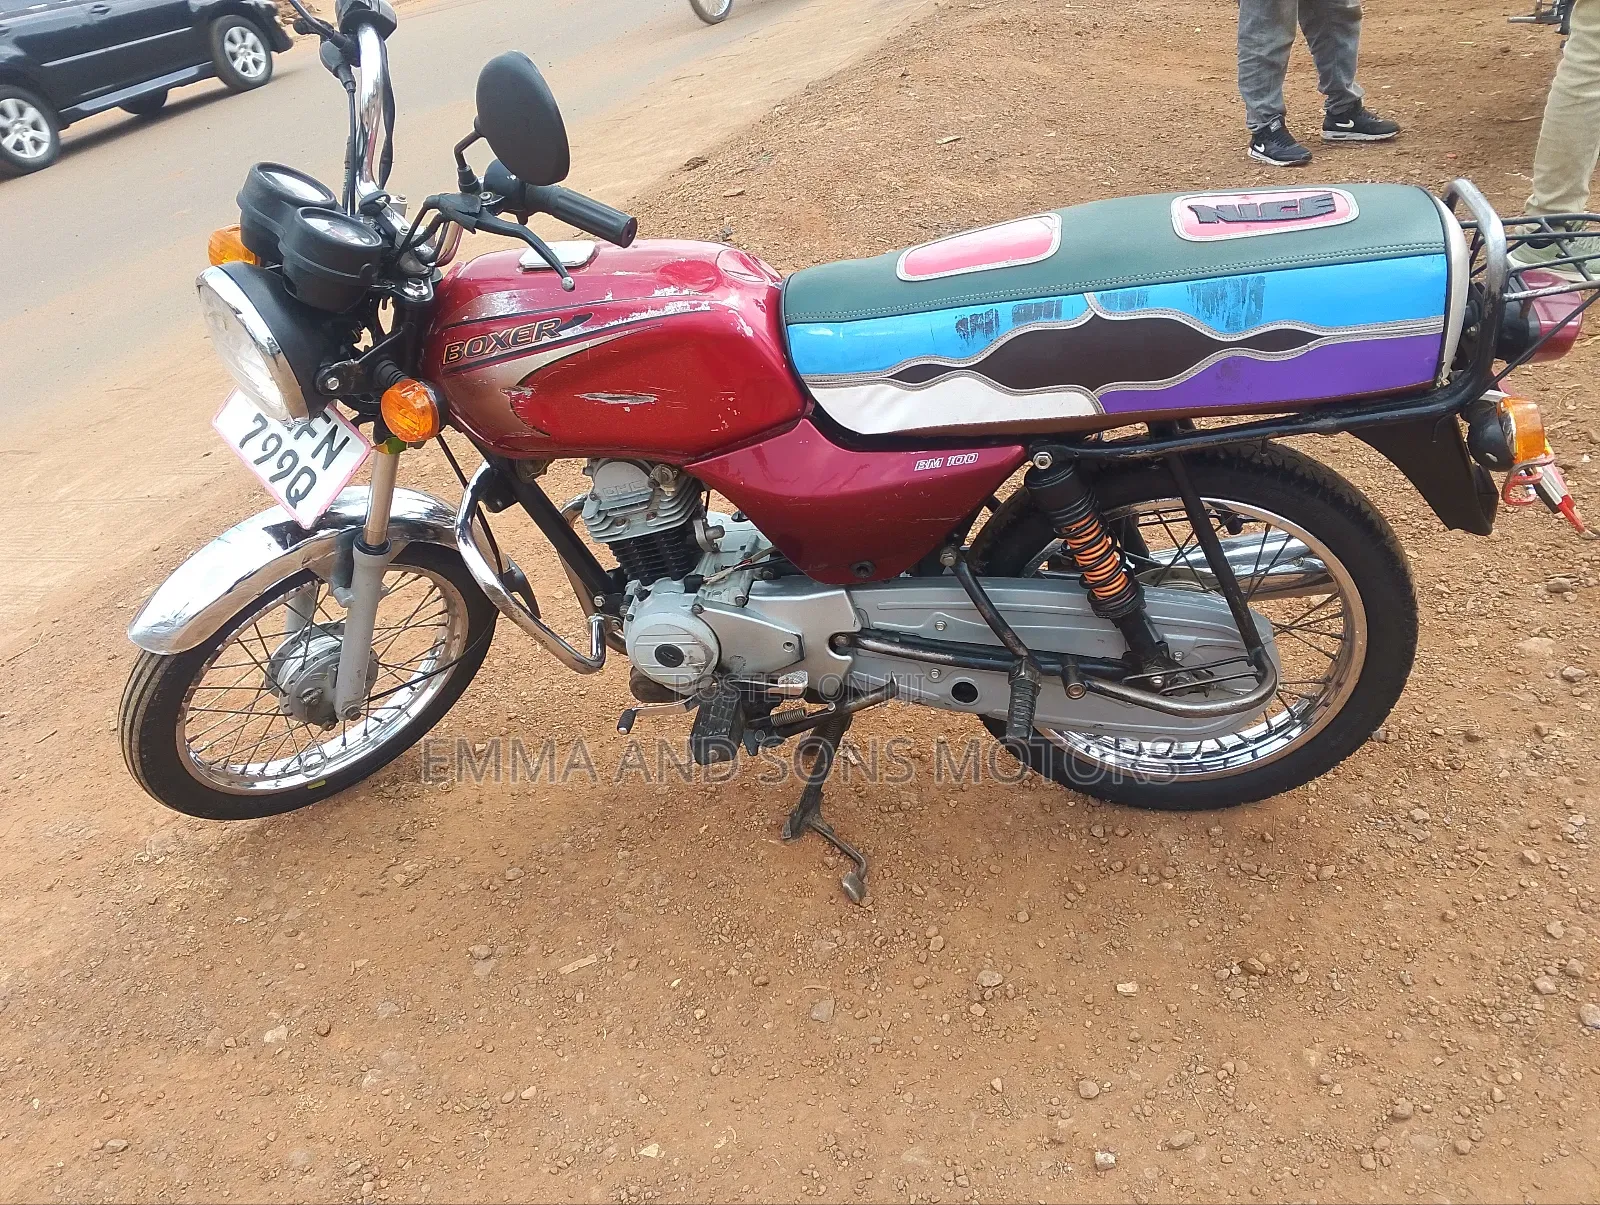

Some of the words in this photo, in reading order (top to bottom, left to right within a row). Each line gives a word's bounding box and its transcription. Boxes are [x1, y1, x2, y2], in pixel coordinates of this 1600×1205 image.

[1187, 192, 1337, 225] NICE
[442, 317, 563, 365] BOXER
[238, 412, 317, 510] 799Q
[914, 457, 944, 471] BM
[946, 452, 979, 466] 100
